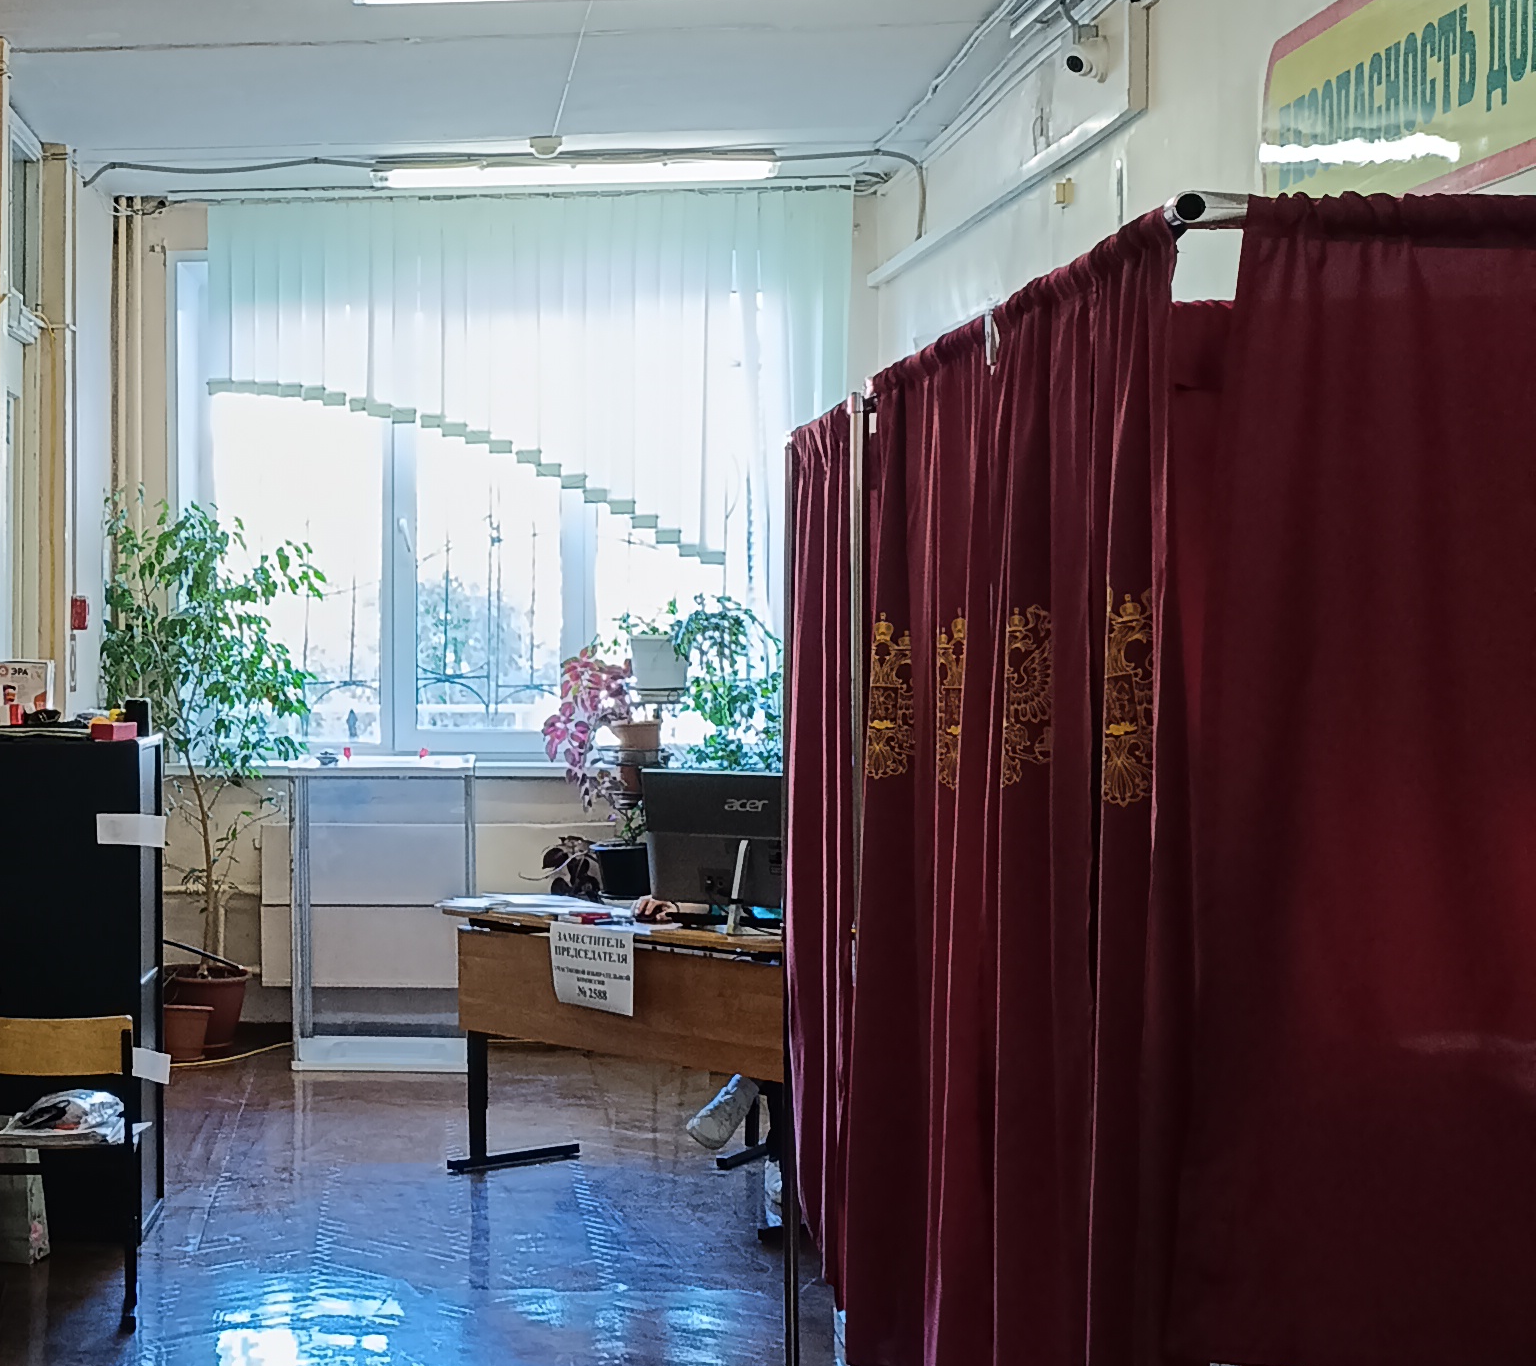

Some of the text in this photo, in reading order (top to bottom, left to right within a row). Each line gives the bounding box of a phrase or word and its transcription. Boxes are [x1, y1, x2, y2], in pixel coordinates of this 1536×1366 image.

[1278, 2, 1477, 191] БЕЗОПАСНОСТЬ
[10, 667, 29, 676] ЭРА
[724, 798, 769, 812] acer
[557, 931, 626, 949] ЗАМЕСТИТЕЛЬ
[554, 945, 628, 965] ПРЕДСЕДАТЕЛЯ
[588, 987, 608, 1001] 2588
